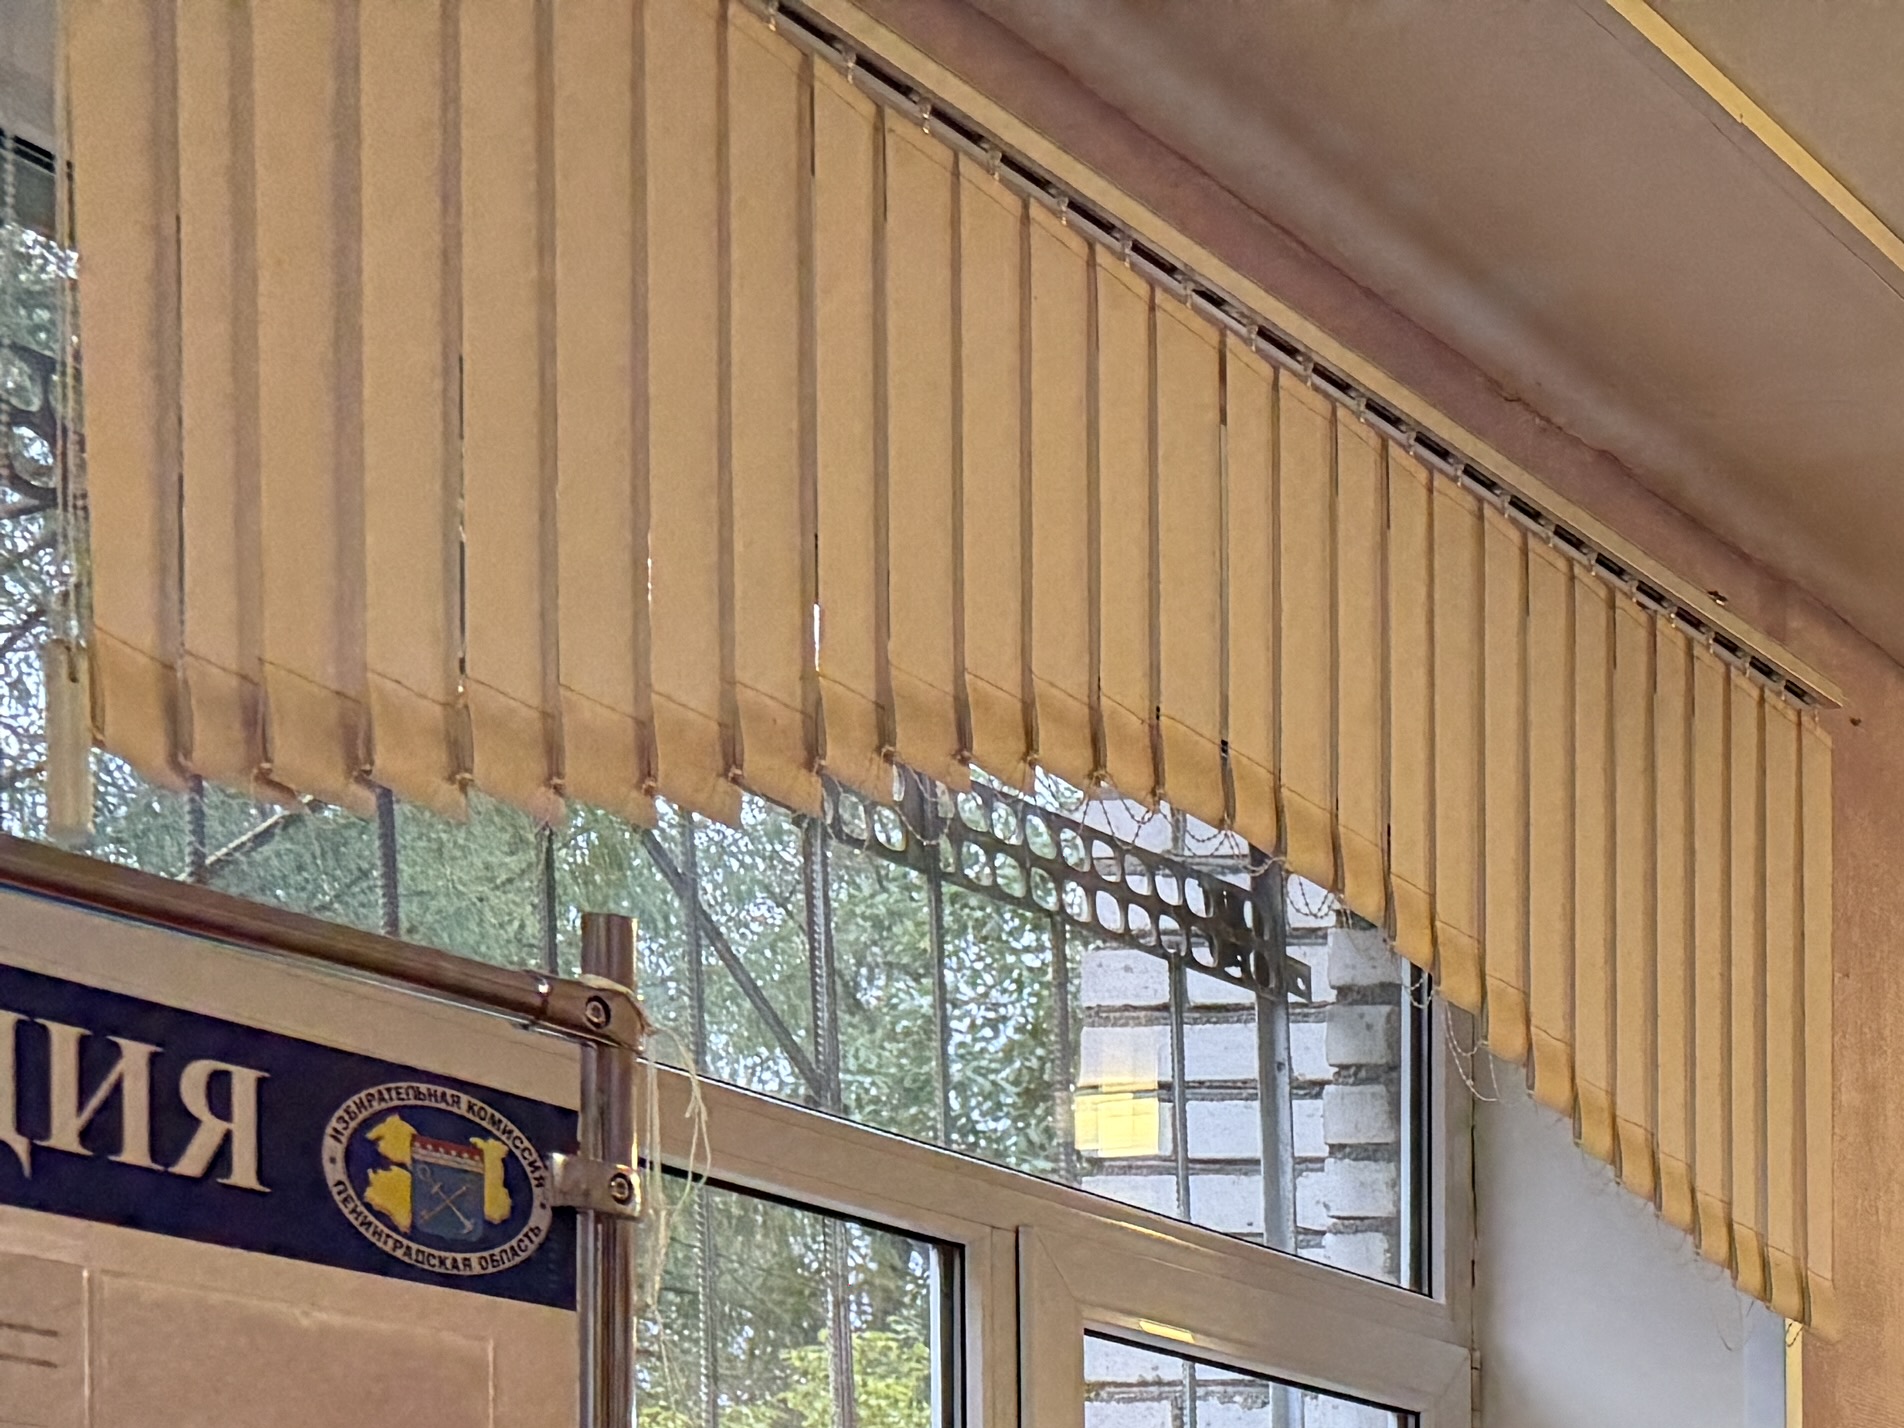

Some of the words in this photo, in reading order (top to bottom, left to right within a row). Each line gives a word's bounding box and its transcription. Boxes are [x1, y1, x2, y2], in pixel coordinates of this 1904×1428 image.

[0, 1009, 272, 1192] ИЯ
[328, 1085, 463, 1145] ИЗБИРАТЕЛЬНАЯ
[466, 1101, 548, 1189] КОМИССИЯ
[333, 1179, 473, 1272] ЛЕНИНГРАДСКАЯ
[479, 1225, 543, 1271] ОБЛАСТЬ
